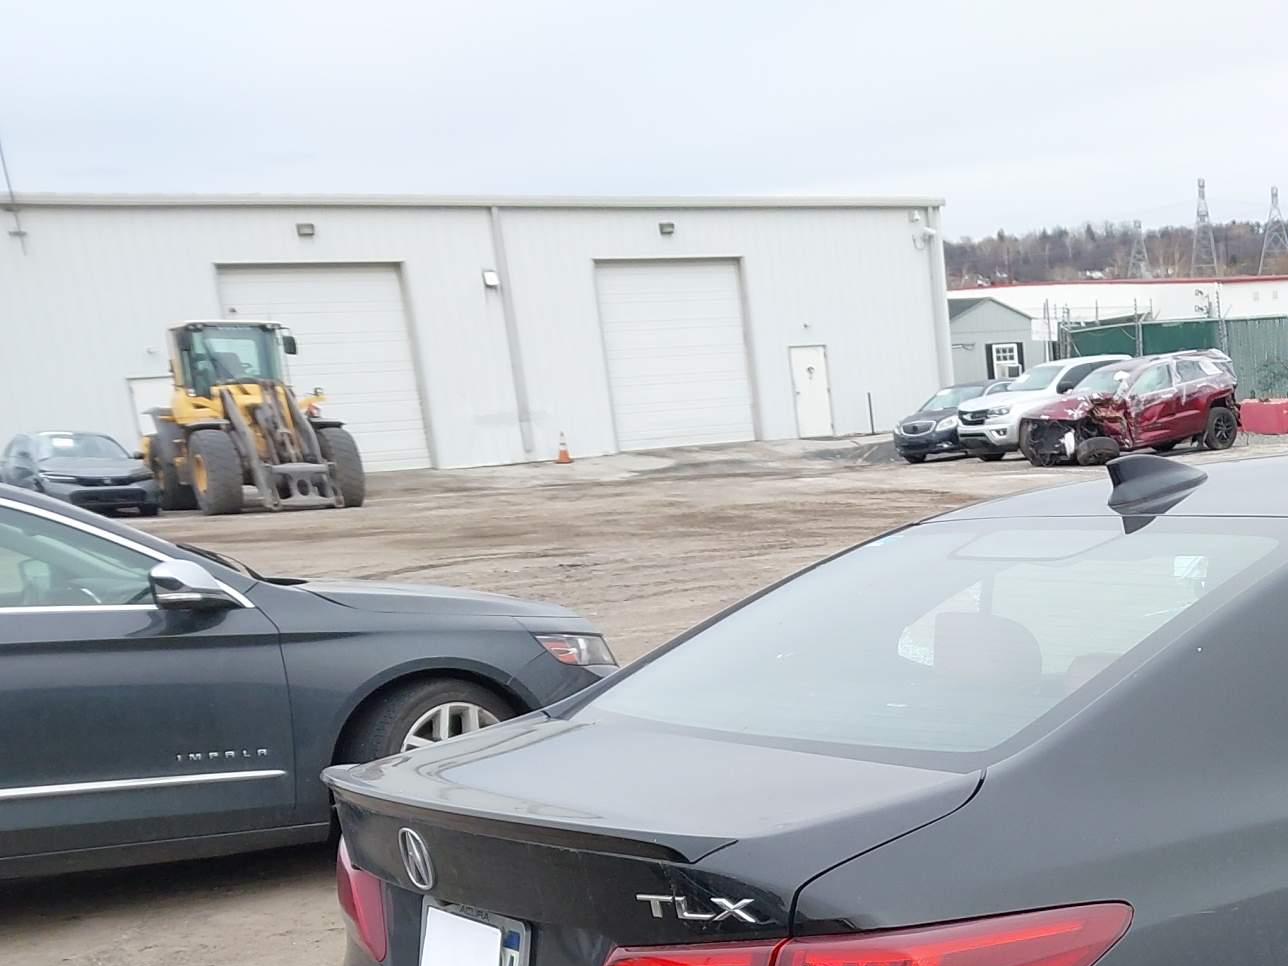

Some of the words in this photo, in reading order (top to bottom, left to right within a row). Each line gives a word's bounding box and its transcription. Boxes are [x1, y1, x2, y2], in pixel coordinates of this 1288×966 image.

[177, 748, 268, 761] IMPALA
[459, 903, 490, 921] ACURA
[635, 893, 756, 923] TLX
